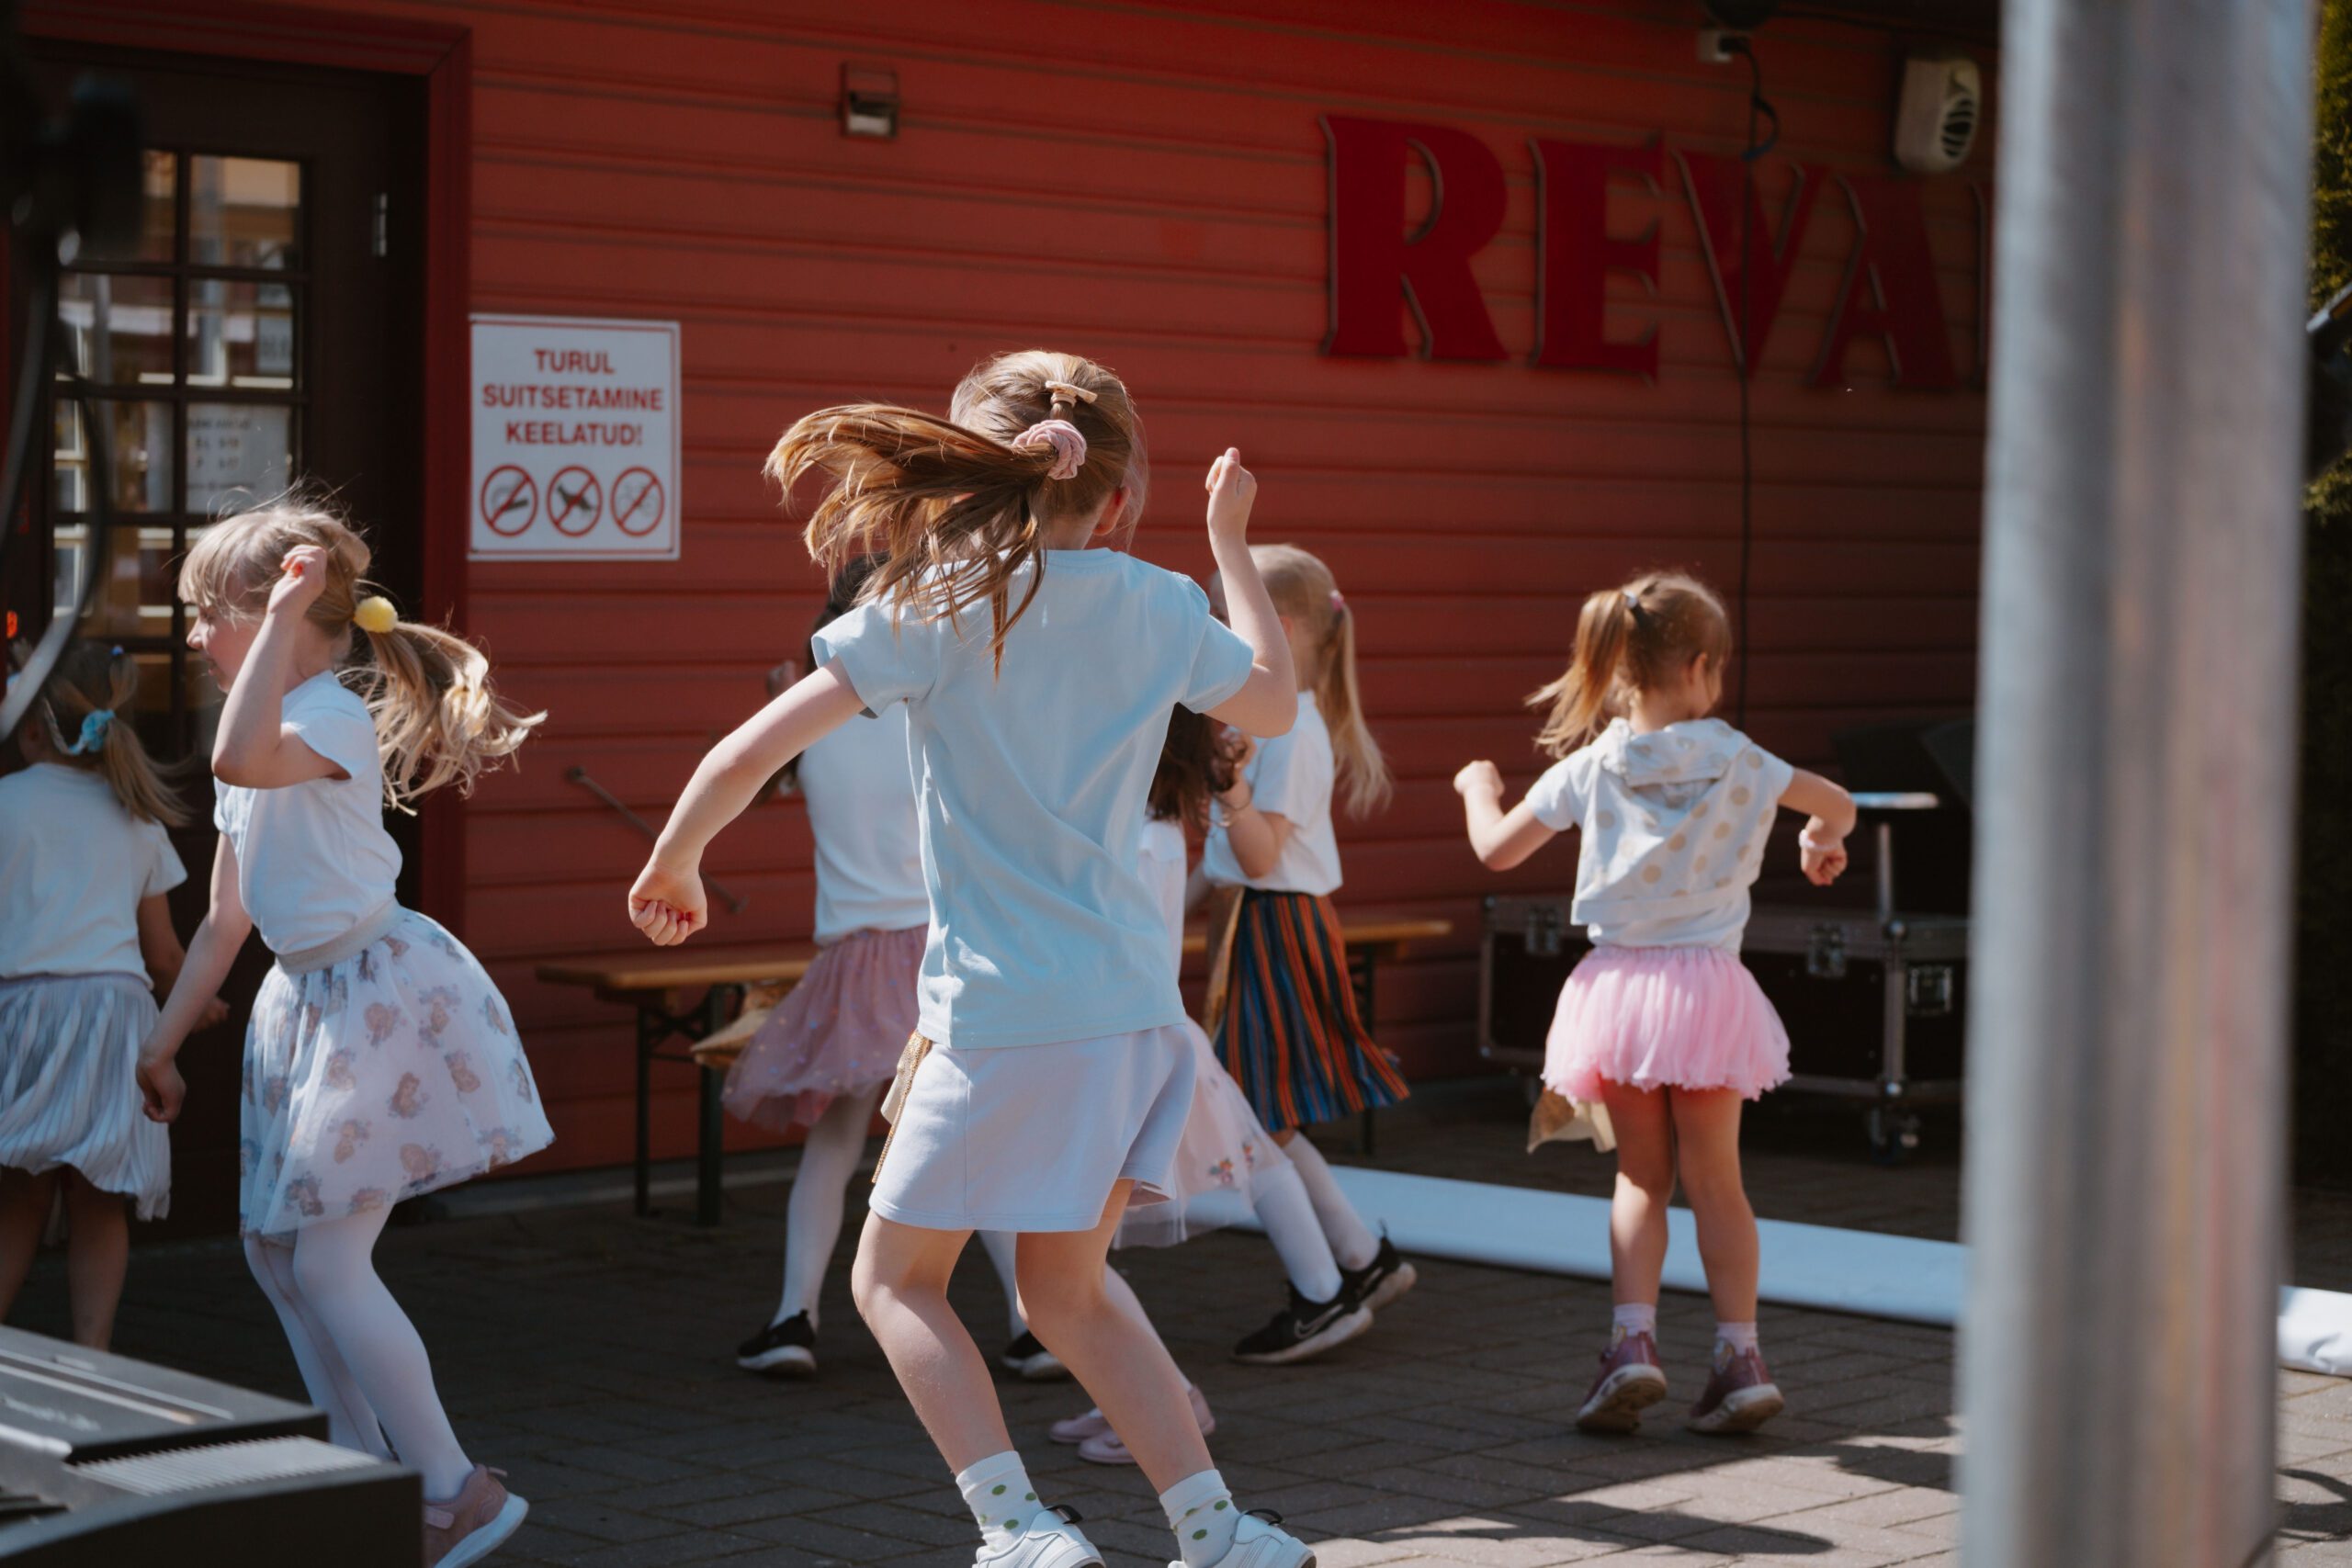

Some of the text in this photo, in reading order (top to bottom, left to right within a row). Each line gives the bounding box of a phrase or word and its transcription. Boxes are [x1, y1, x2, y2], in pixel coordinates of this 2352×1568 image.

[1318, 114, 1990, 389] REVA
[535, 349, 615, 374] TURUL
[482, 383, 663, 411] SUITSETAMINE
[506, 422, 642, 446] KEELATUD!
